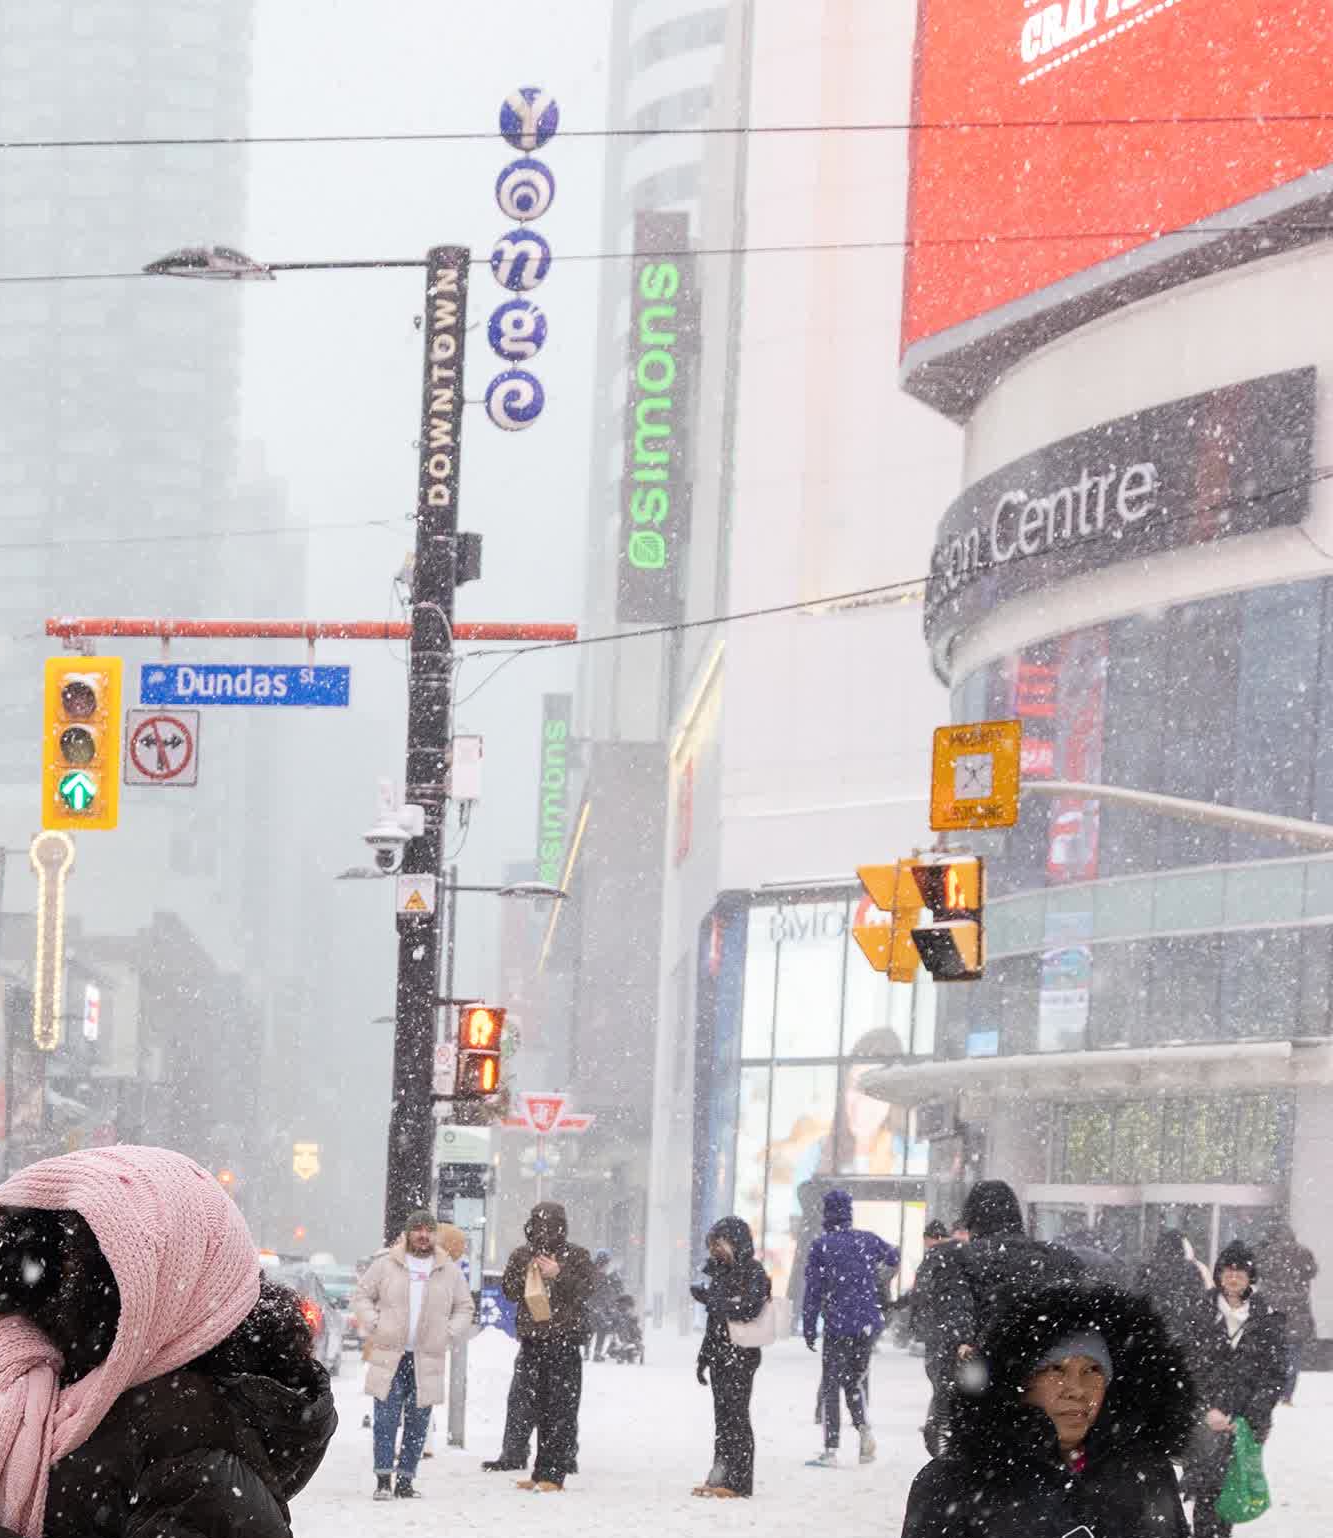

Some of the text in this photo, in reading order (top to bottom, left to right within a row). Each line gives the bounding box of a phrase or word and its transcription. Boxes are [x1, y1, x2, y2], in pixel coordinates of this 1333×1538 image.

[486, 86, 559, 430] Yonge
[428, 267, 460, 507] DOWNTOWN
[631, 262, 680, 526] simons
[990, 462, 1159, 562] Centre
[176, 667, 289, 698] Dundas
[300, 668, 317, 684] St
